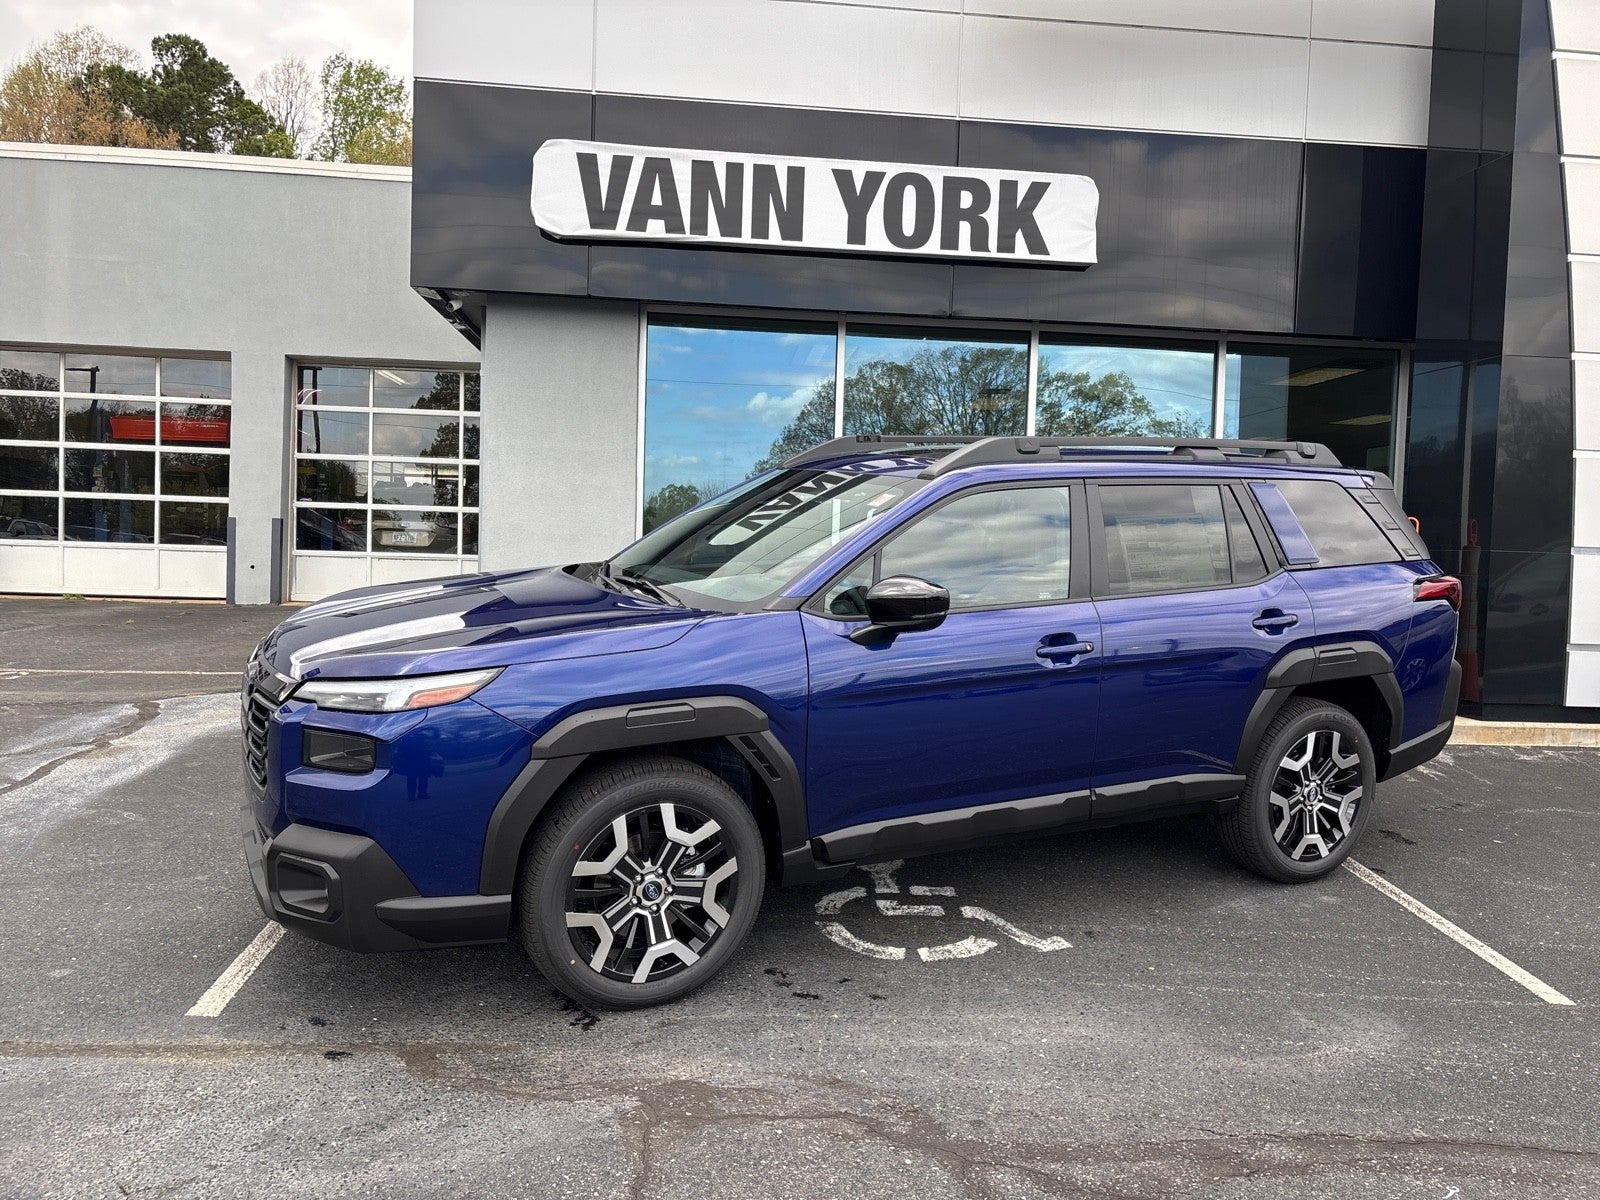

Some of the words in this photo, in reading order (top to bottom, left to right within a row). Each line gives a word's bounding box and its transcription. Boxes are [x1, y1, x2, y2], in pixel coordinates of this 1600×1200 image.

[576, 152, 805, 242] VANN
[831, 168, 1052, 256] YORK
[623, 780, 713, 799] BRIDGESTONE
